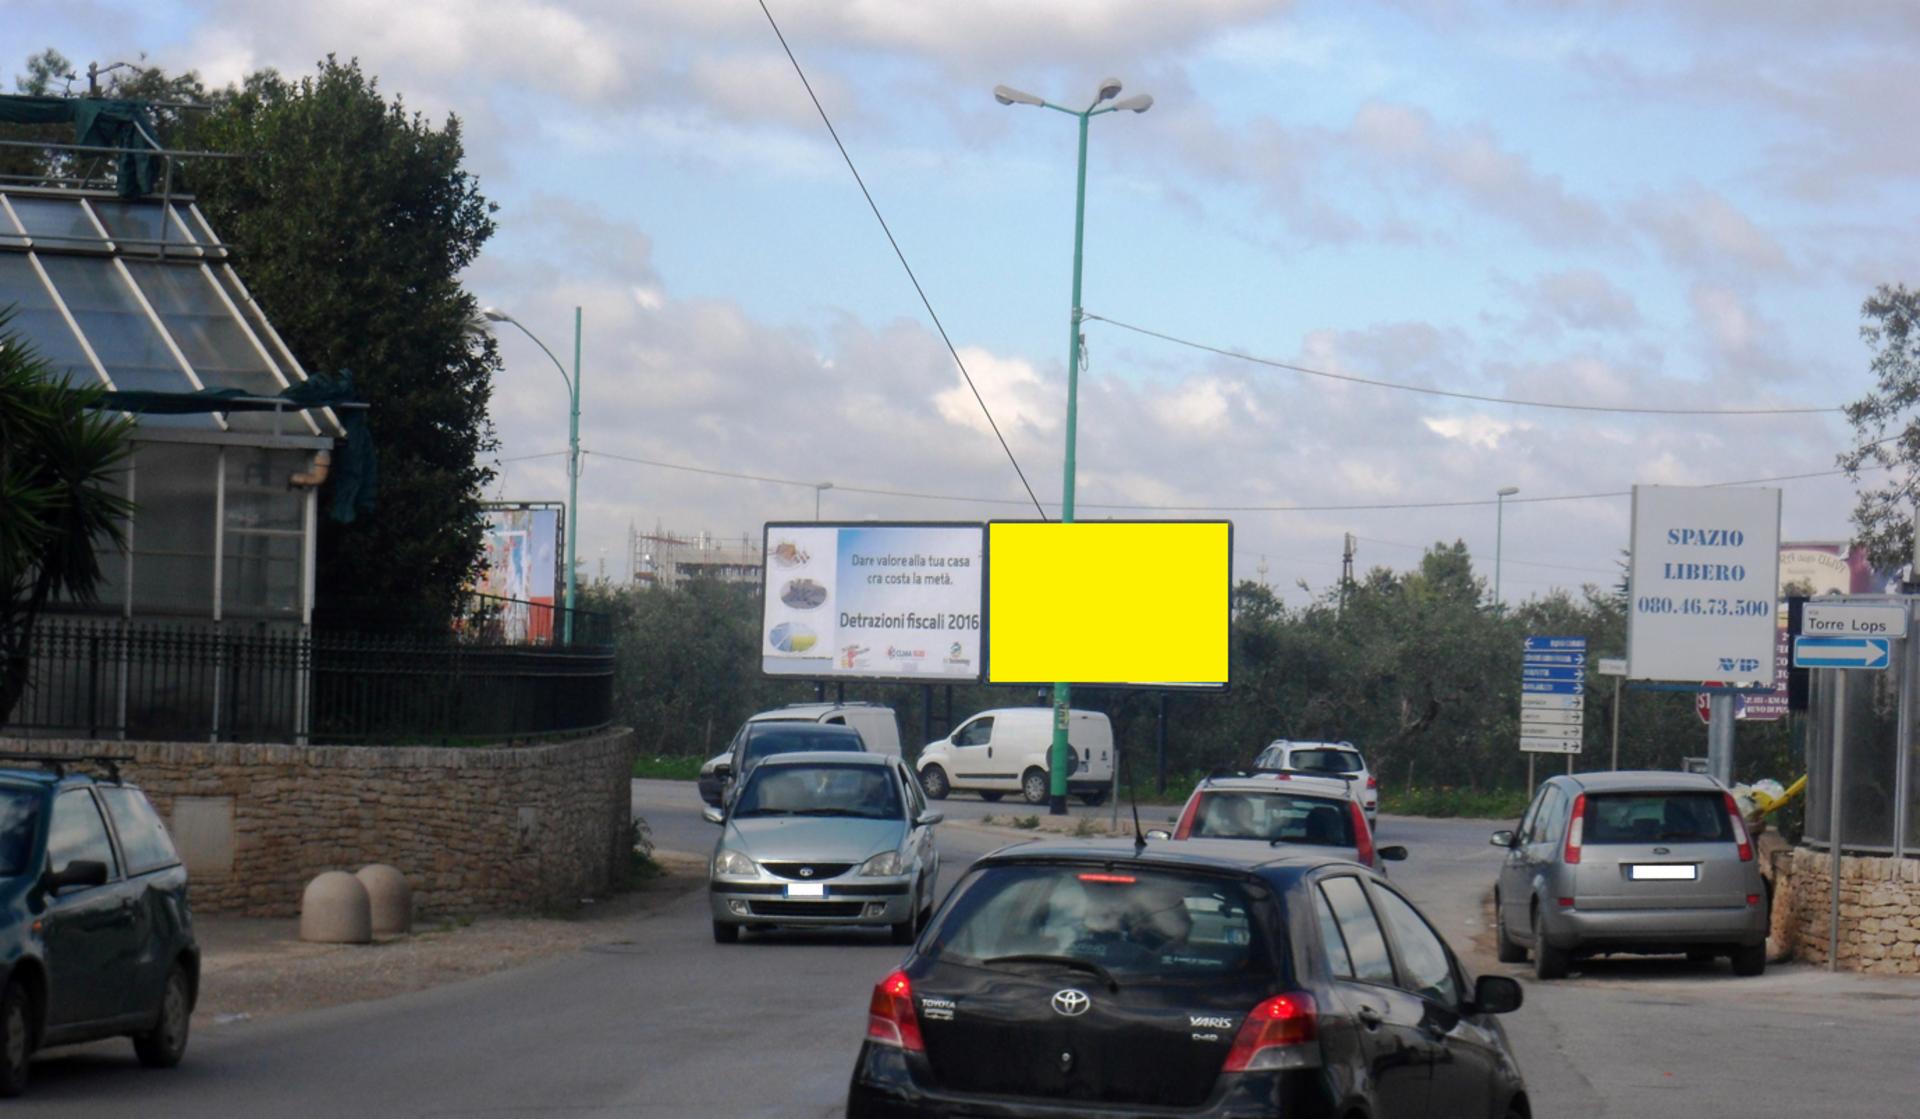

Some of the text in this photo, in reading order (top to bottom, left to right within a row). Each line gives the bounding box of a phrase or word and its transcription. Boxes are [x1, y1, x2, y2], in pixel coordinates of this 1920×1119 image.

[1667, 528, 1744, 547] SPAZIO
[851, 554, 970, 568] Dare valore alla tua casa
[884, 573, 910, 585] costa
[912, 571, 922, 585] la
[1664, 562, 1746, 582] LIBERO
[1638, 596, 1769, 617] 080.46.73.500
[839, 612, 980, 630] Detrazioni fiscali 2016
[1808, 617, 1887, 634] Torre Lops
[921, 998, 956, 1009] TOYOTA
